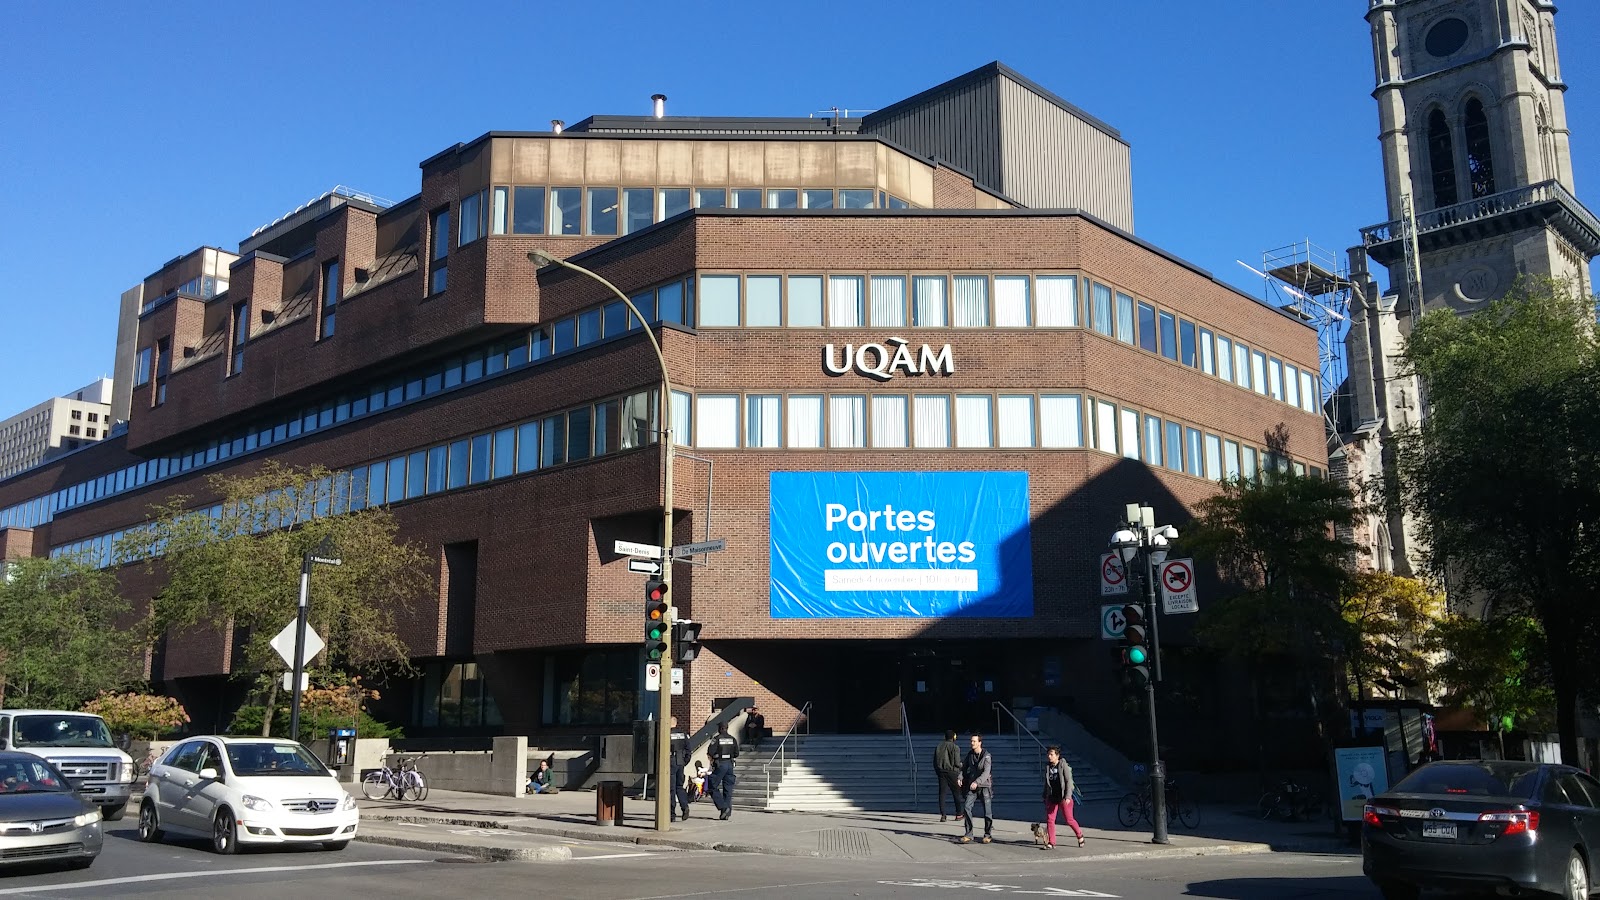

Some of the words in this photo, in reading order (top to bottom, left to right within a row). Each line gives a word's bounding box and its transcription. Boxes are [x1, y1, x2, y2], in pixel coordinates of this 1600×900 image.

[822, 337, 955, 381] UQÀM
[826, 503, 936, 532] Portes
[618, 545, 650, 556] Saint-Denis
[689, 544, 722, 553] Maisonneuve
[826, 535, 976, 563] ouvertes
